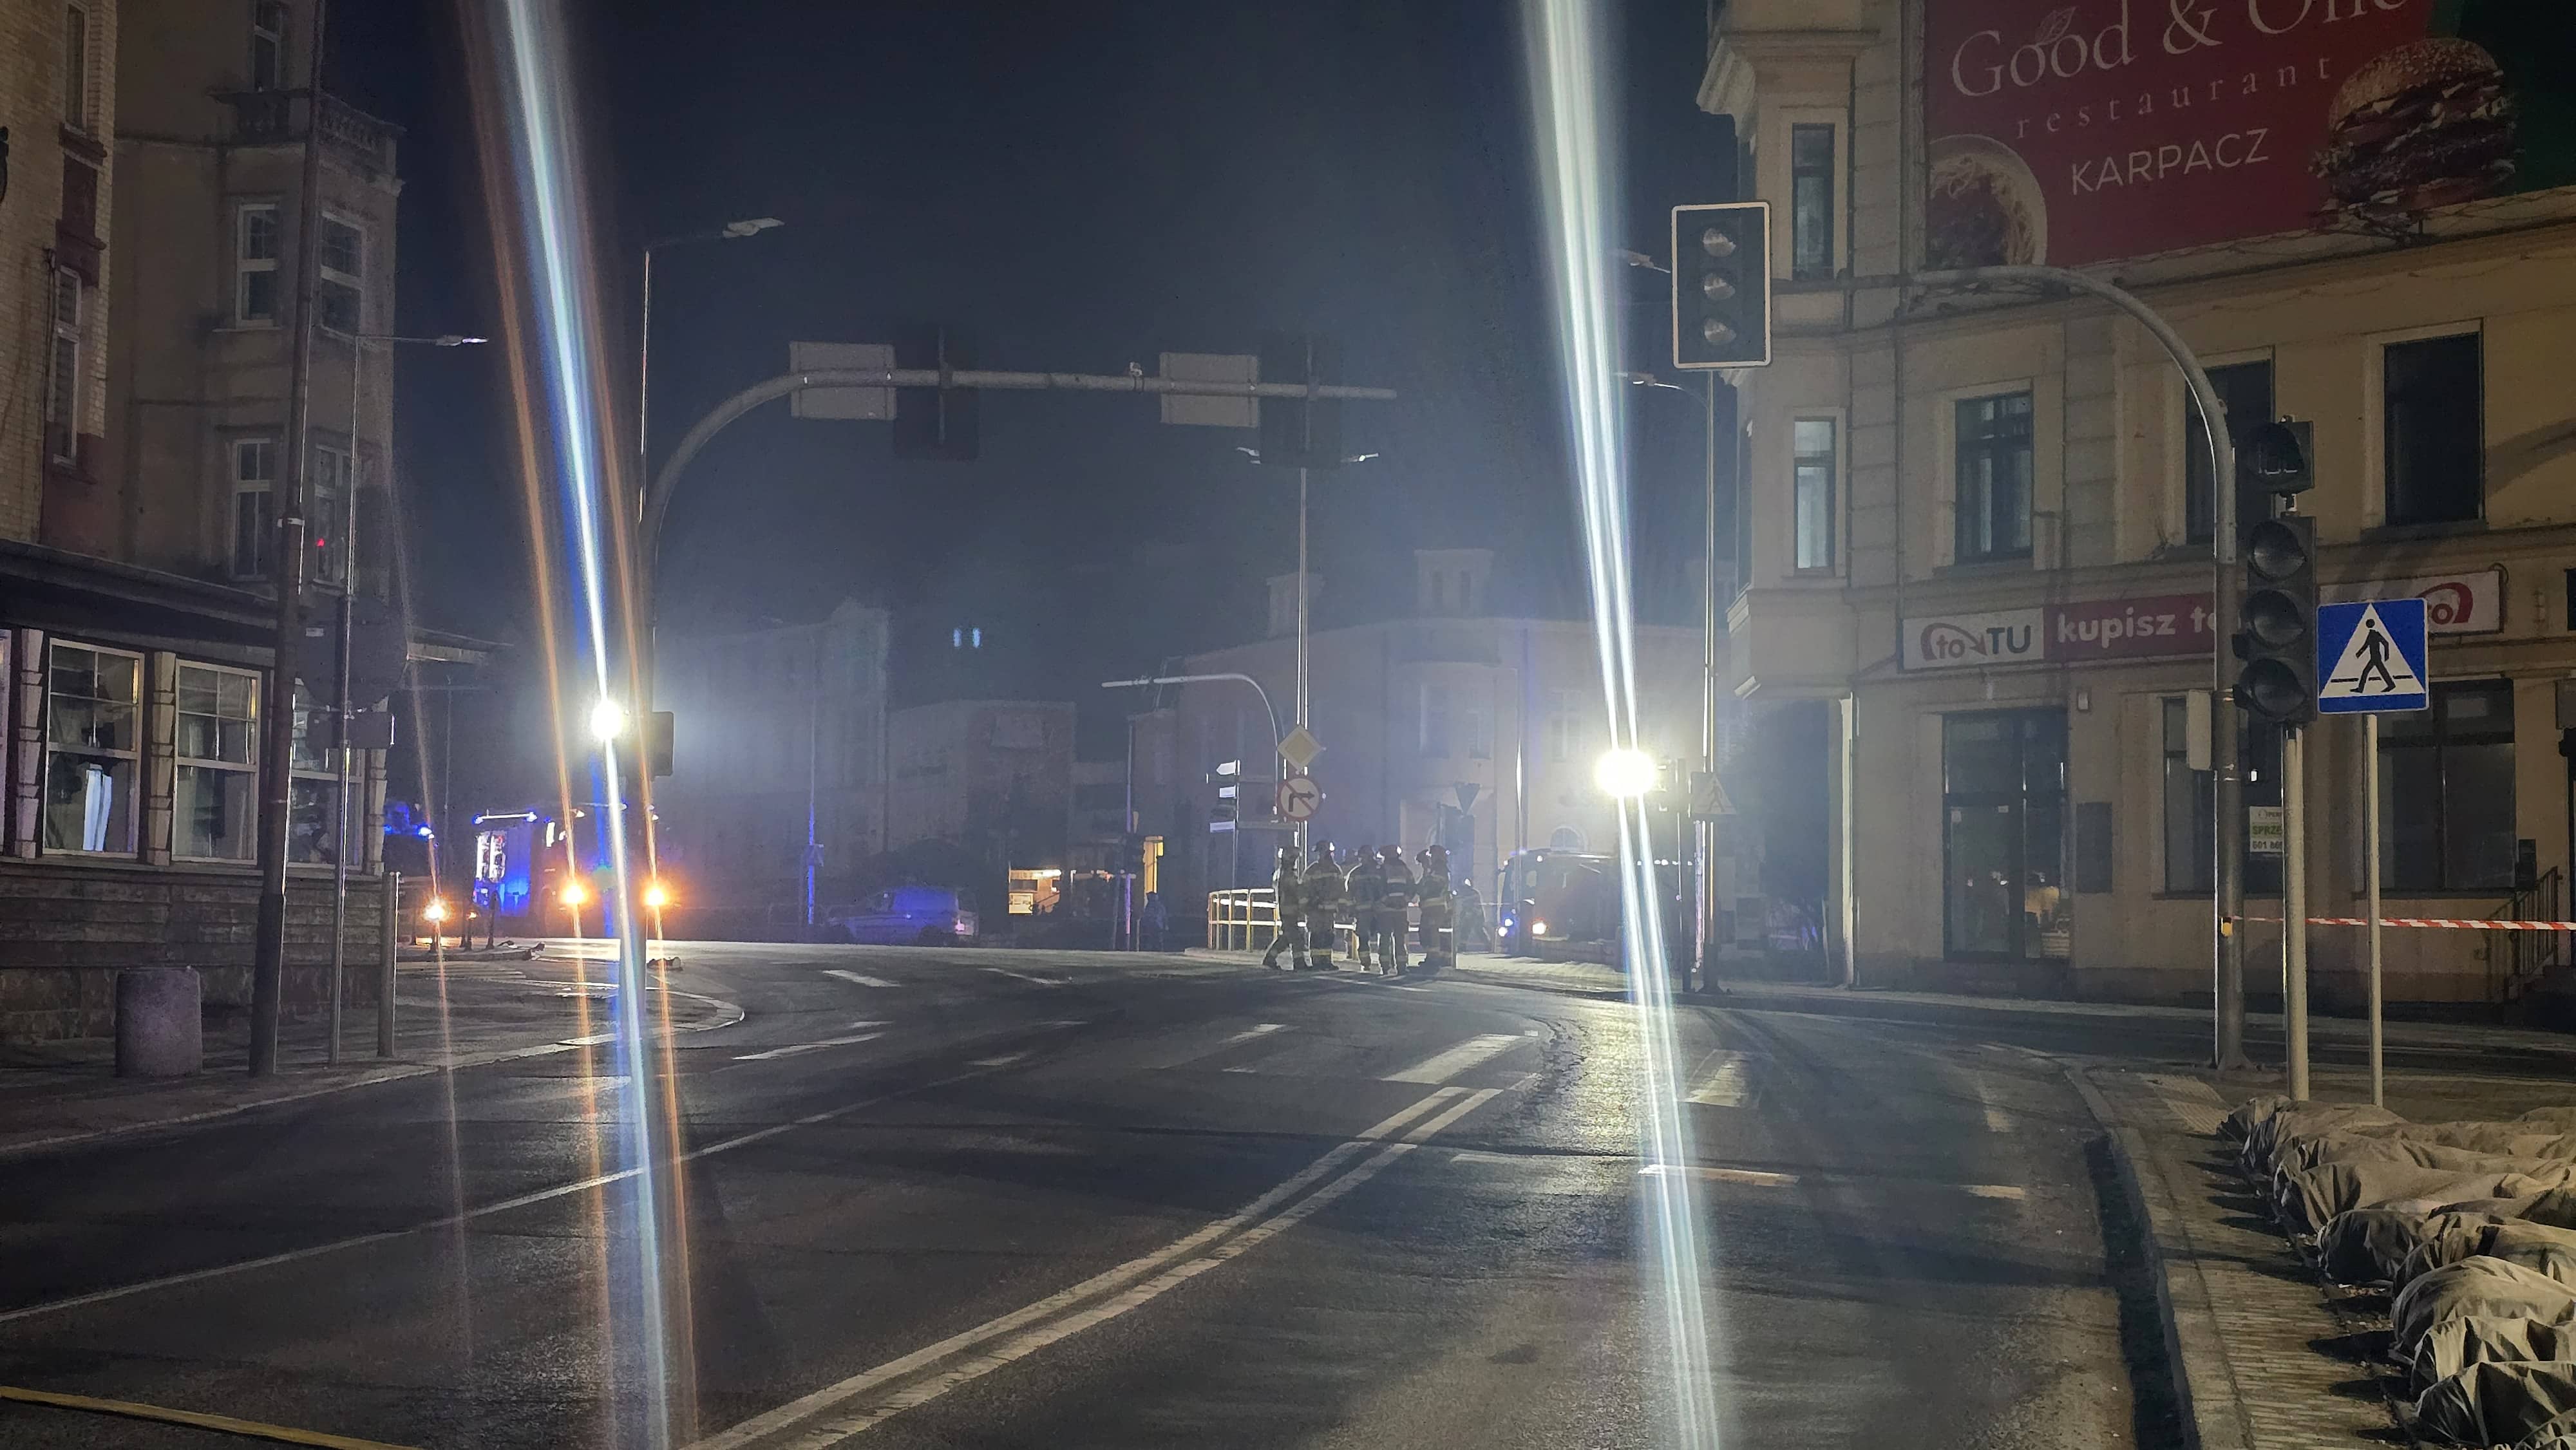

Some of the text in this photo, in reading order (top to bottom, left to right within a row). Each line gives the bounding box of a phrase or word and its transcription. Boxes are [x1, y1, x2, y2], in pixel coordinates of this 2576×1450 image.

[1951, 0, 2137, 97] Good
[2163, 0, 2222, 55] &
[2016, 56, 2333, 139] restaurant
[2071, 128, 2270, 196] KARPACZ
[2058, 607, 2177, 649] kupisz
